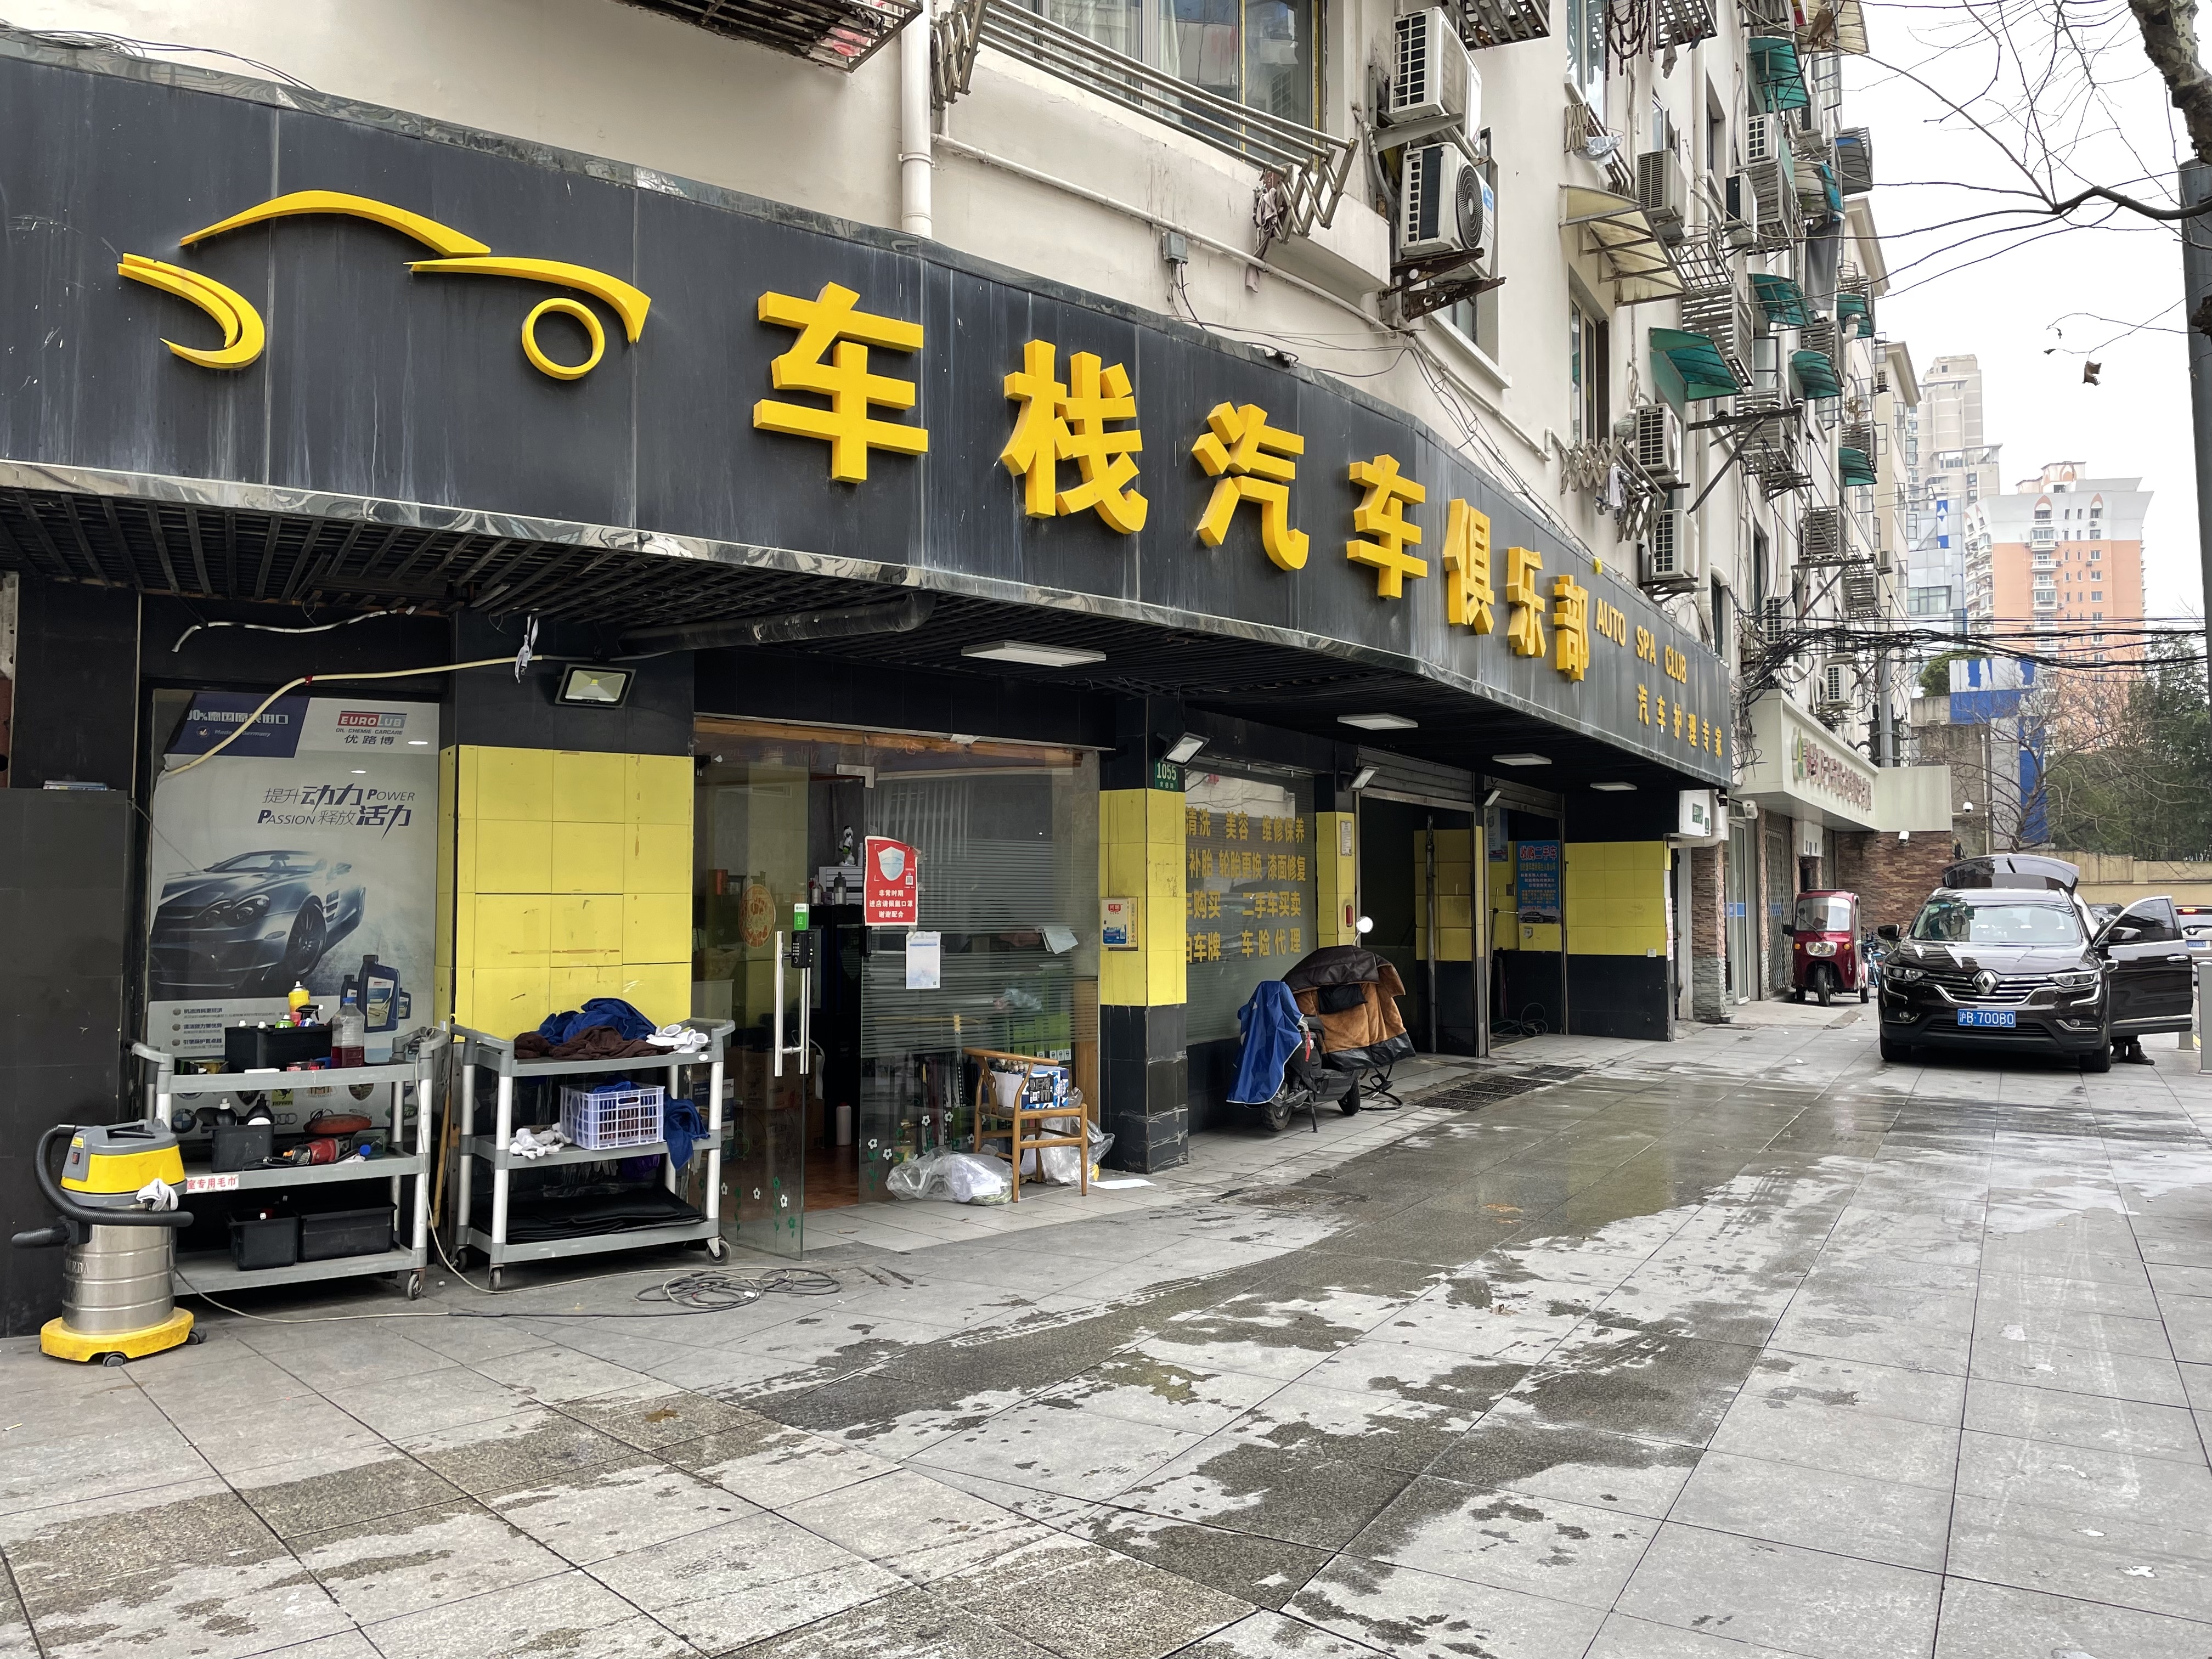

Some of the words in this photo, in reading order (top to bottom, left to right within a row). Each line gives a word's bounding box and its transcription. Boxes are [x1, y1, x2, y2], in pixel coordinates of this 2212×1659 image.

[753, 281, 1590, 682] 车栈汽车俱乐部
[1595, 597, 1627, 647] AUTO
[1636, 625, 1657, 666] SPA
[1664, 644, 1688, 684] CLUB
[340, 714, 403, 727] EUROLUB
[1638, 684, 1722, 758] 汽车护理专家
[344, 735, 394, 745] 优路博
[1156, 762, 1177, 781] 1055
[262, 783, 364, 814] 提升动力
[366, 789, 415, 801] POWER
[318, 804, 412, 840] 释放活力
[1186, 806, 1211, 837] 清洗
[1226, 810, 1249, 841] 美容
[1262, 815, 1305, 843] 维修保养
[1189, 848, 1213, 878] 补胎
[1219, 850, 1262, 879] 轮胎更换
[1267, 853, 1306, 882] 漆面修复
[1520, 845, 1558, 861] 收购二手车
[1242, 890, 1301, 919] 二手车买卖
[1242, 928, 1301, 958] 车险代理
[187, 1176, 236, 1190] 室专用毛巾
